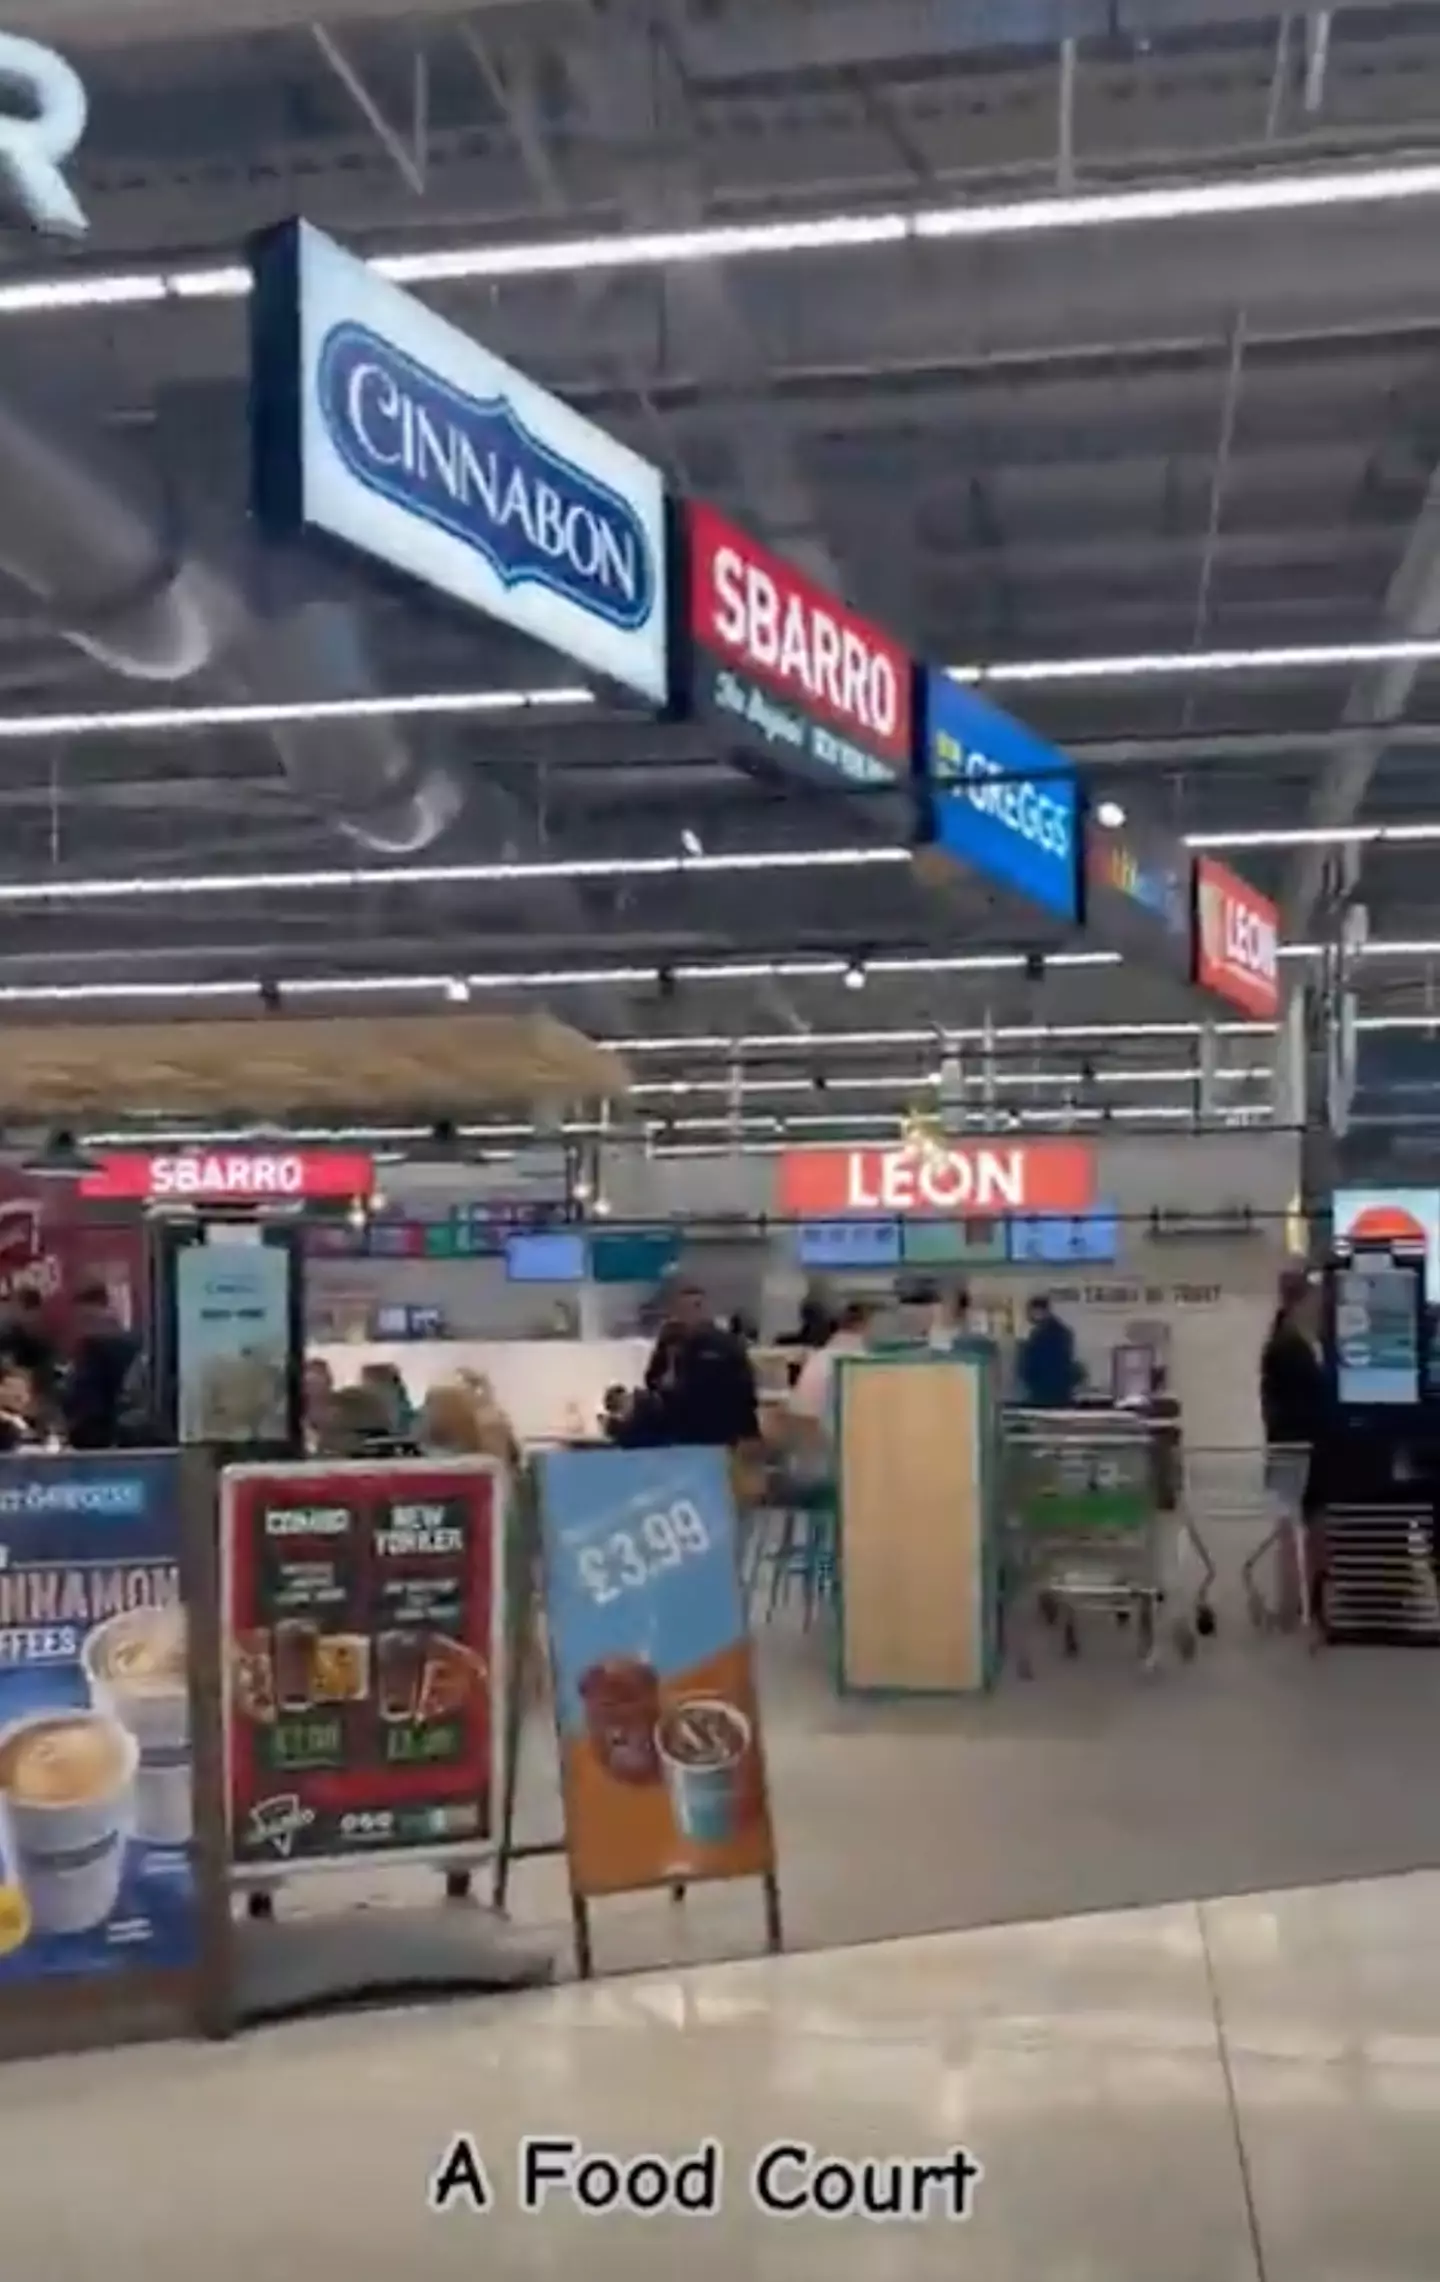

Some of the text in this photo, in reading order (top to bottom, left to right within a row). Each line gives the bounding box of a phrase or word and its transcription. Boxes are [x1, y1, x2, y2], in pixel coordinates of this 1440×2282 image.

[349, 362, 635, 601] CINNABON
[714, 546, 897, 736] SBARRO
[965, 752, 1068, 860] GREGGS
[149, 1156, 304, 1193] SBARRO
[848, 1149, 1026, 1208] LEON
[374, 1527, 463, 1556] YORKER
[391, 1504, 445, 1528] NEW
[577, 1499, 709, 1607] £3.99
